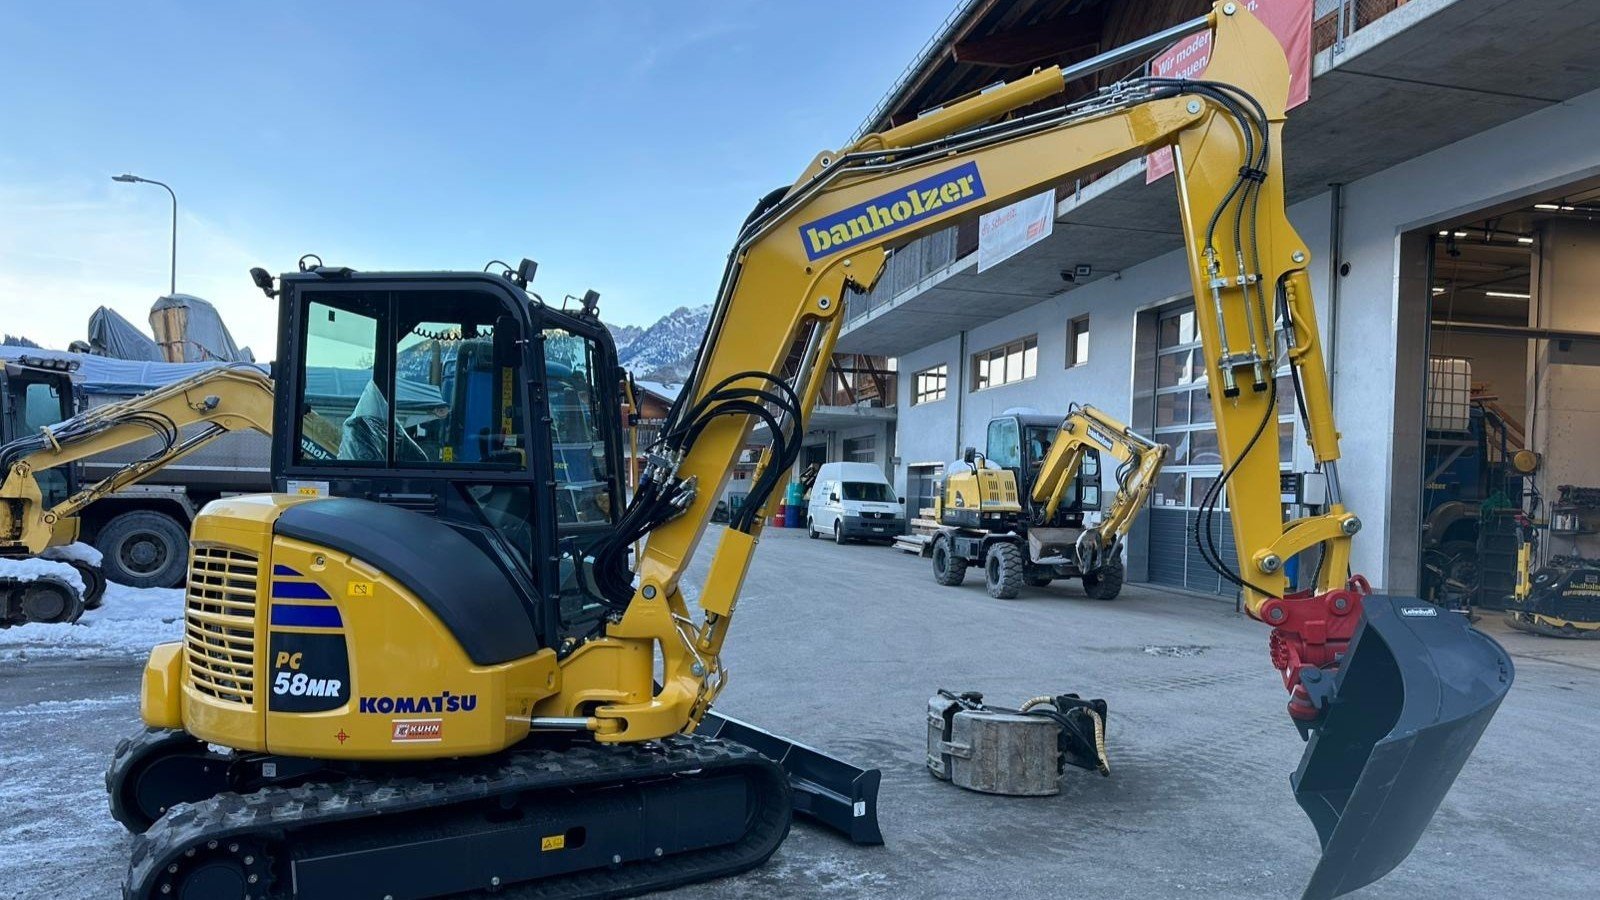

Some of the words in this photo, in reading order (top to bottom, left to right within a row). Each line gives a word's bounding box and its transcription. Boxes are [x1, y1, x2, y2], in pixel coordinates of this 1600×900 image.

[1159, 56, 1175, 77] Wir
[1176, 31, 1210, 64] moder
[807, 174, 974, 253] banholzer
[275, 651, 302, 670] PC
[273, 672, 341, 697] 58MR
[360, 691, 477, 714] KOMATSU
